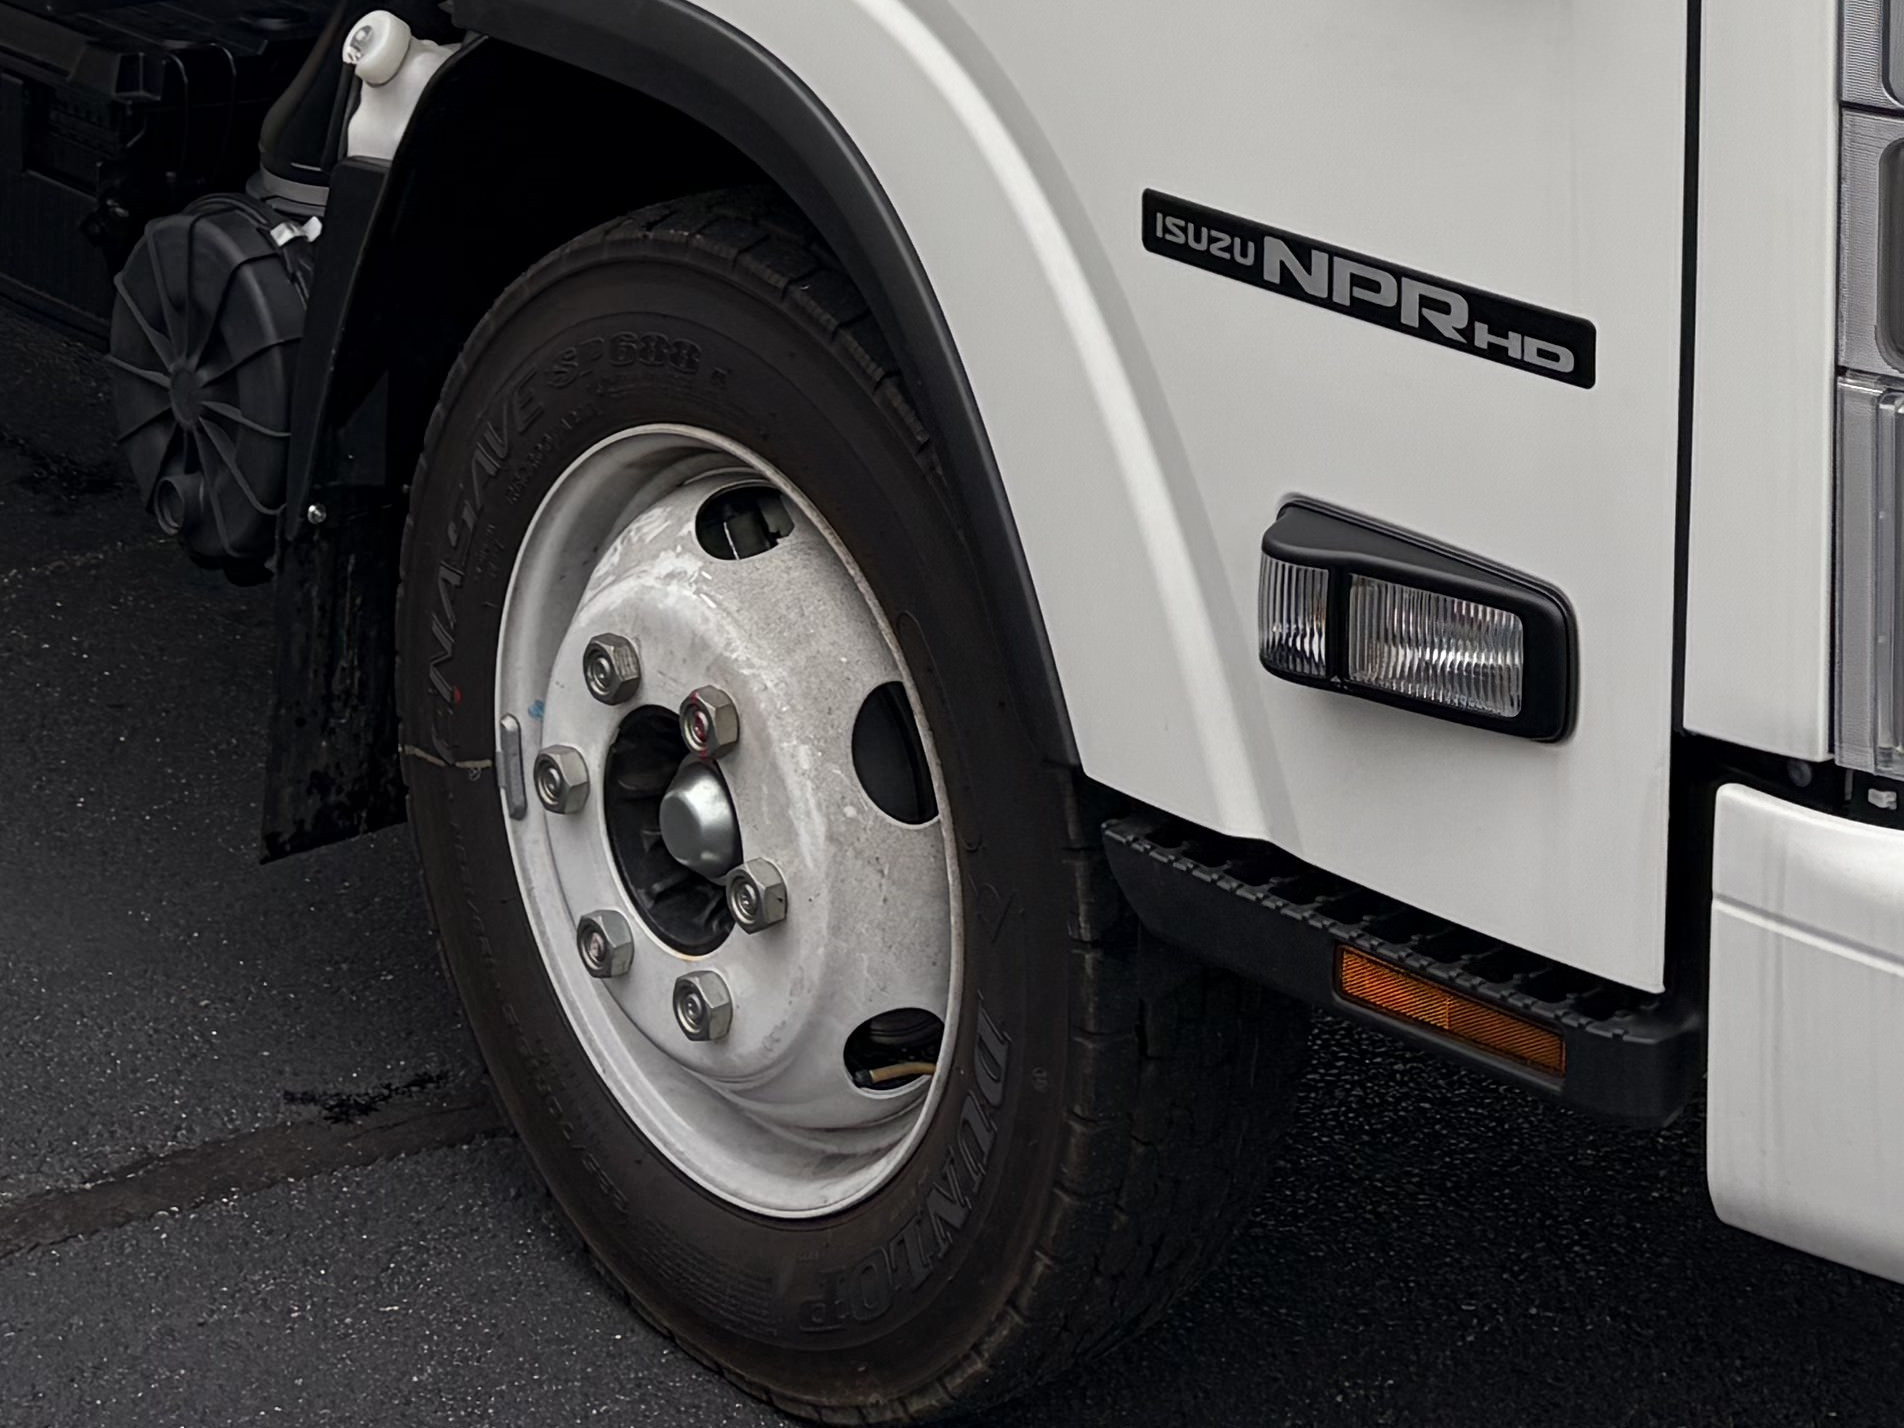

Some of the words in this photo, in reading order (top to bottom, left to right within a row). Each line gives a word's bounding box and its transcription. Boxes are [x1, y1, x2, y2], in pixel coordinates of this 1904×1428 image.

[1156, 211, 1255, 266] ISUZU
[1263, 235, 1469, 344] NPR
[1474, 321, 1575, 374] HD
[798, 988, 1013, 1335] DUNLOP
